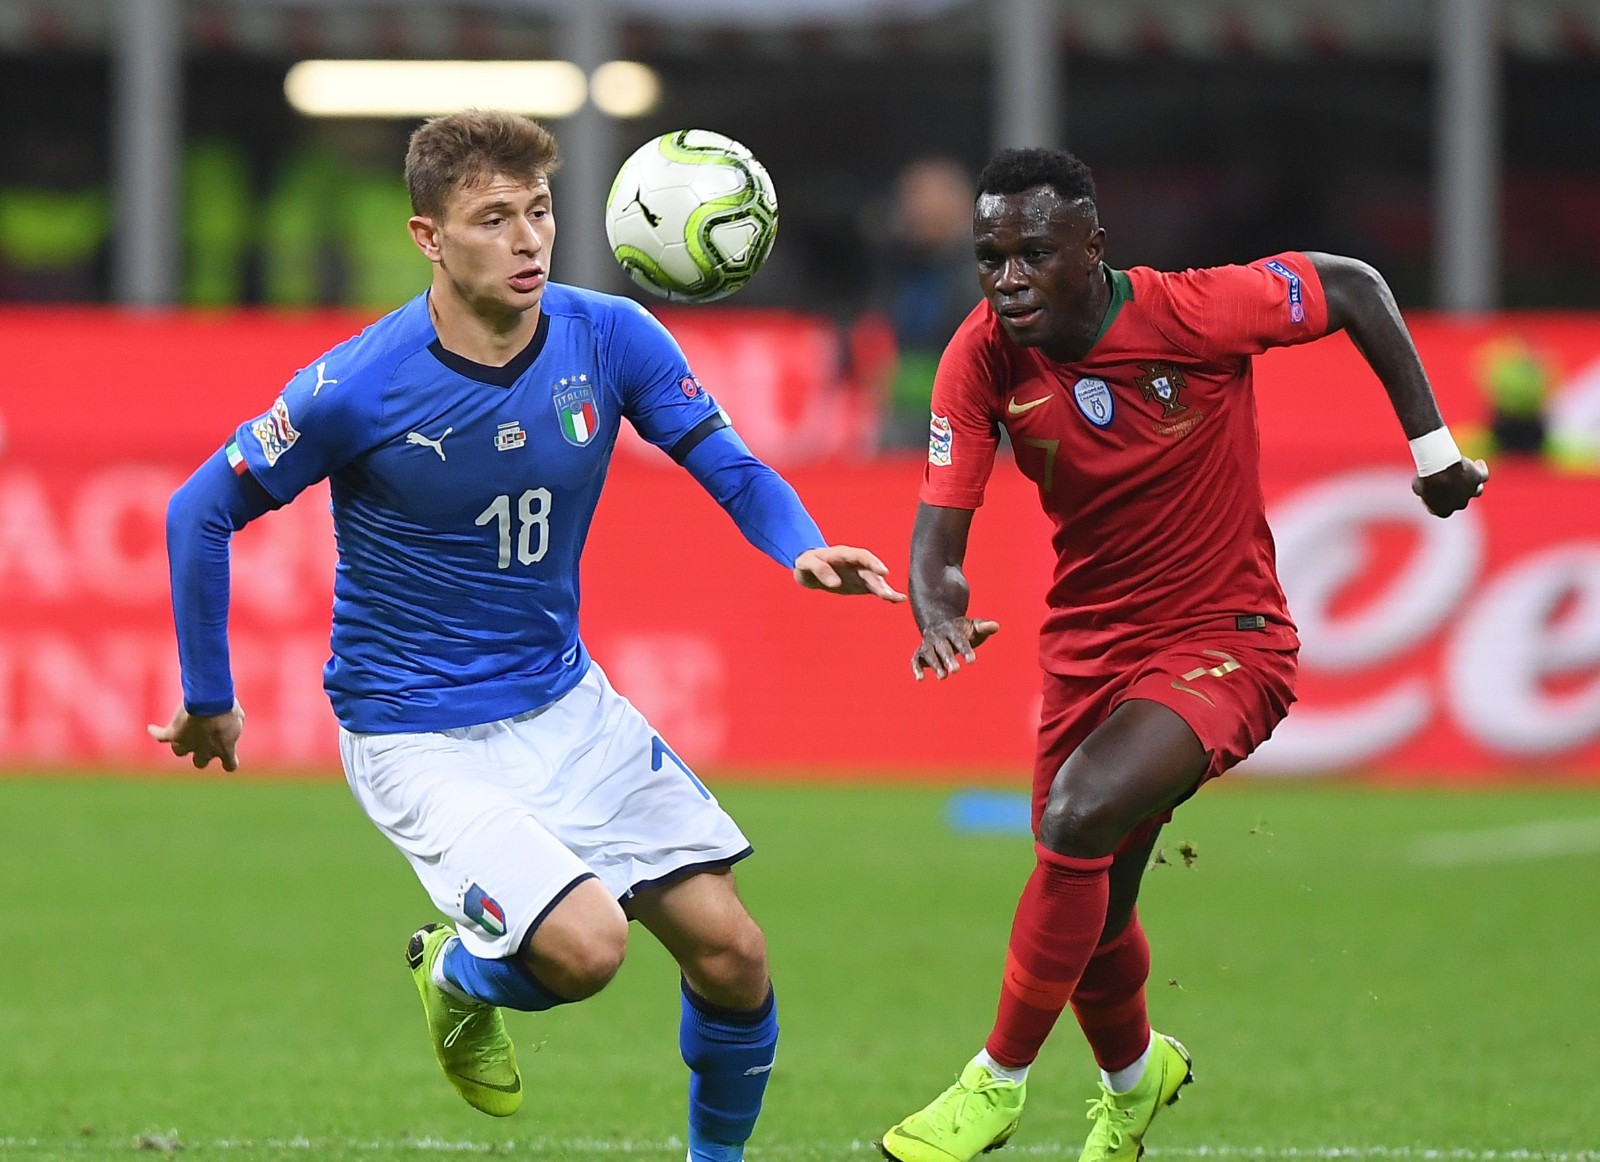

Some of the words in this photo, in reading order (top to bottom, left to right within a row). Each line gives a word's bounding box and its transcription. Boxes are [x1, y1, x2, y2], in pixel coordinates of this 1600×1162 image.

[1268, 262, 1299, 302] RESPECT
[557, 389, 590, 406] ITALIA
[1023, 437, 1060, 493] 7
[475, 487, 552, 569] 18
